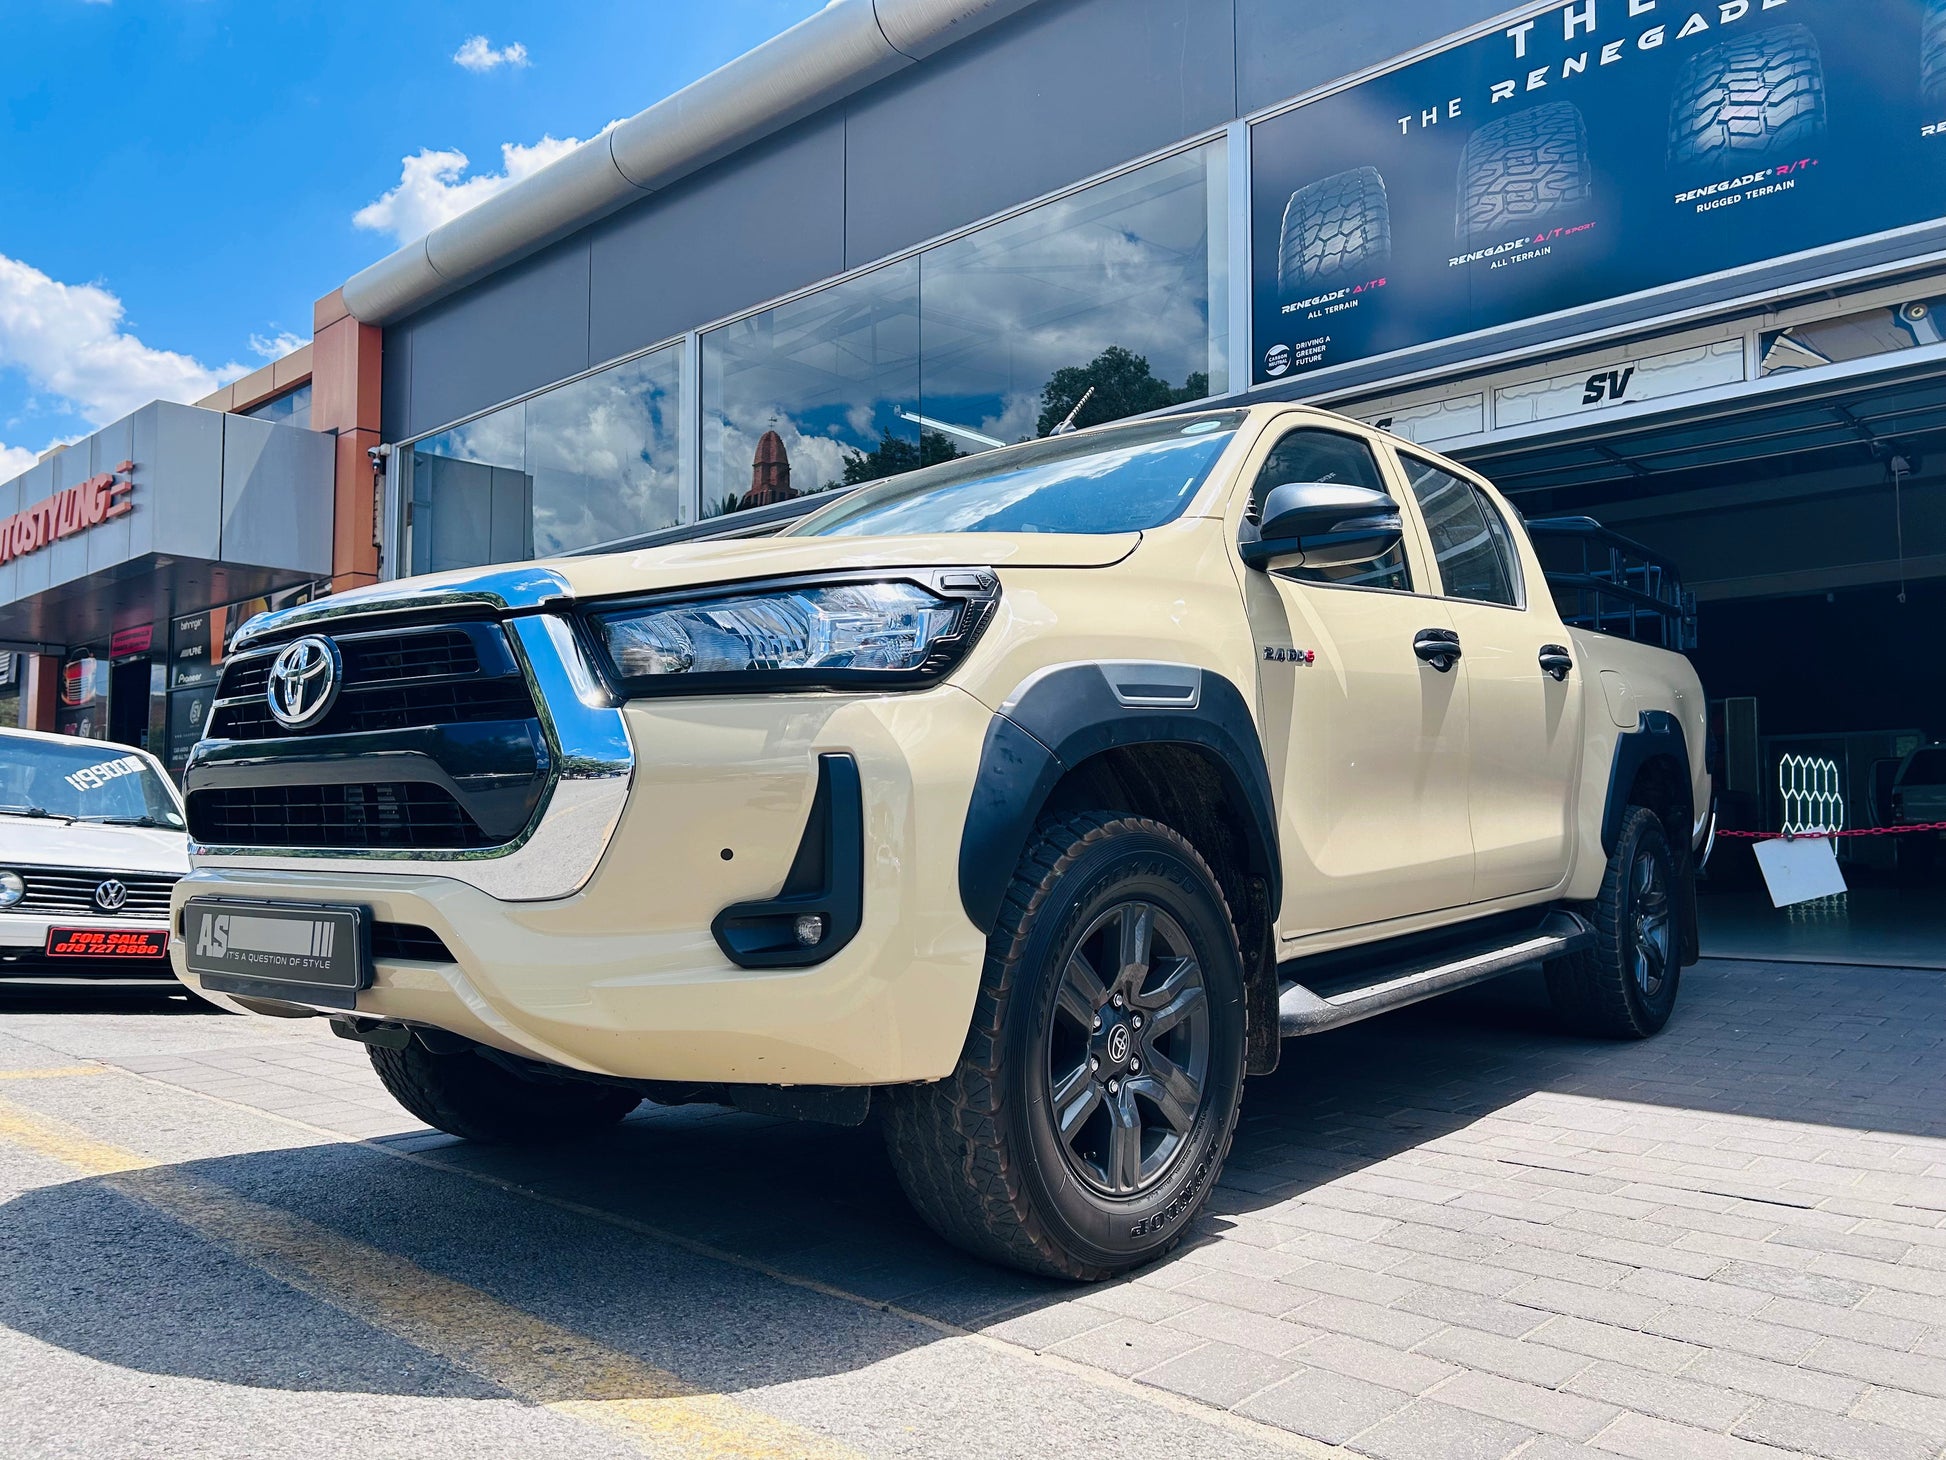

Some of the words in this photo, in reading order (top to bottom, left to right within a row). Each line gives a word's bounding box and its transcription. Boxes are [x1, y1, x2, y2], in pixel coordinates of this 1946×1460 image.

[1398, 98, 1462, 135] THE
[1696, 194, 1742, 213] RUGGED
[1745, 179, 1795, 200] TERRAIN
[1490, 259, 1508, 269] ALL
[1511, 246, 1551, 264] TERRAIN
[1307, 309, 1323, 319] ALL
[1325, 299, 1358, 315] TERRAIN
[1295, 337, 1324, 350] DRIVING
[1268, 353, 1288, 362] CARBON
[1295, 345, 1326, 358] GREENER
[1268, 359, 1288, 368] NEUTRAL
[1295, 353, 1322, 366] FUTURE
[1582, 366, 1635, 405] SV
[69, 932, 106, 943] FOR
[107, 933, 149, 944] SALE
[55, 942, 87, 953] 079
[226, 951, 240, 961] IT'S
[241, 953, 247, 961] A
[248, 953, 287, 965] QUESTION
[289, 957, 301, 966] OF
[302, 959, 331, 969] STYLE
[1130, 1133, 1219, 1239] DUNLOP
